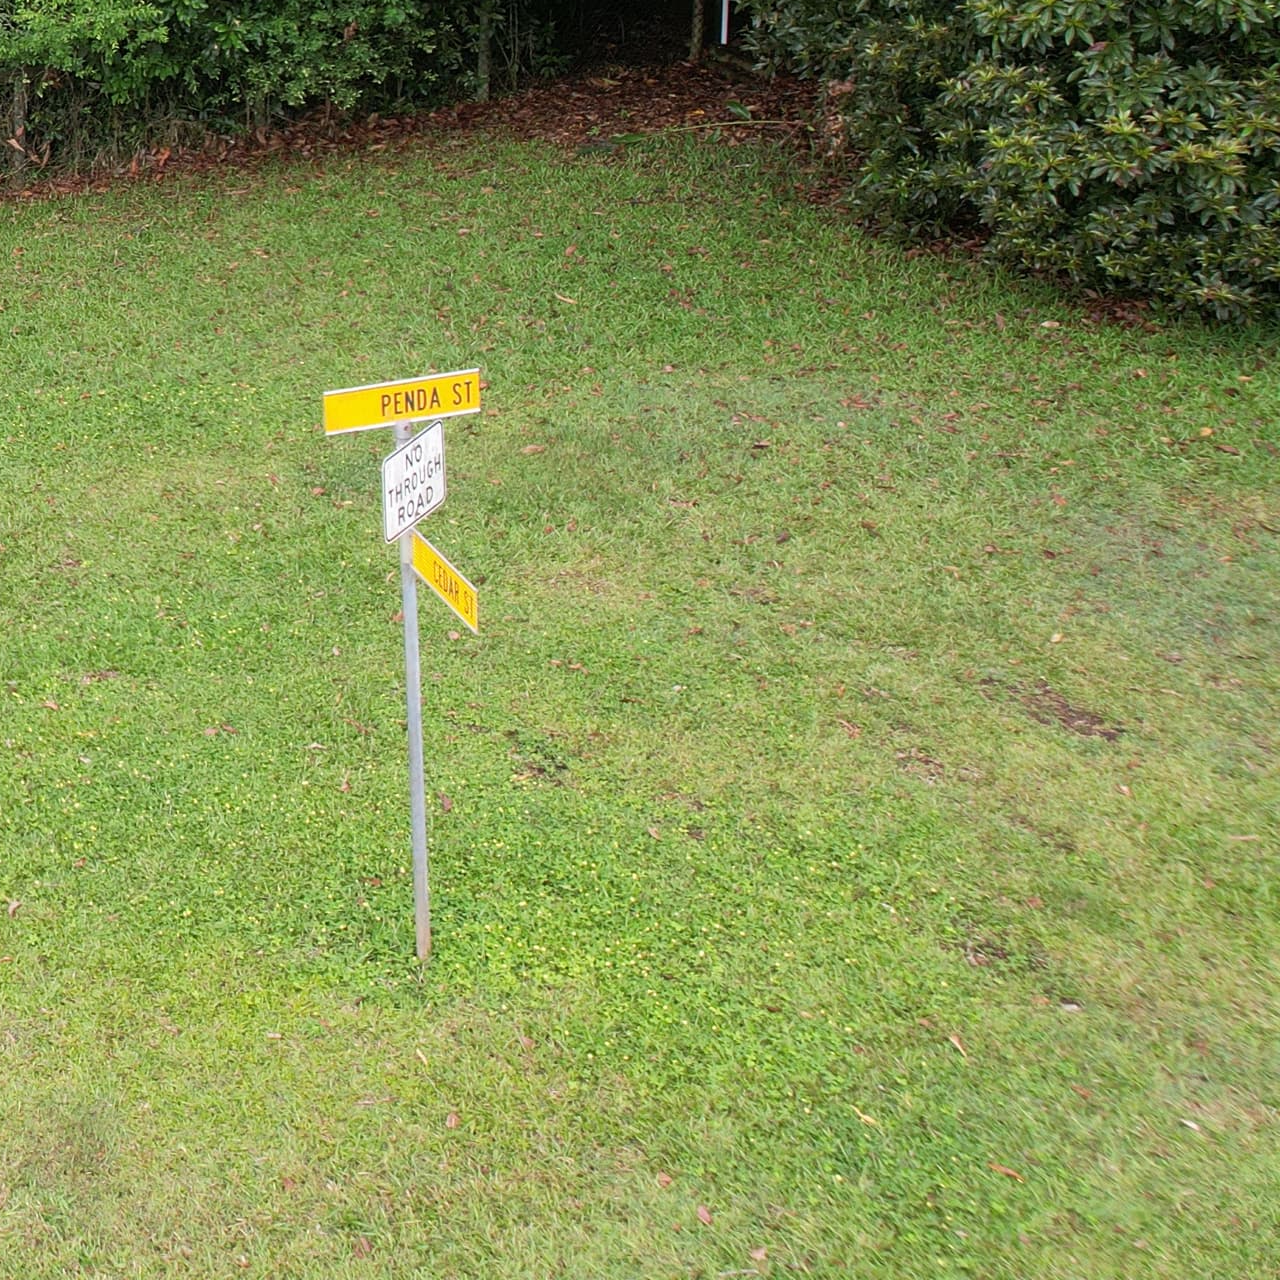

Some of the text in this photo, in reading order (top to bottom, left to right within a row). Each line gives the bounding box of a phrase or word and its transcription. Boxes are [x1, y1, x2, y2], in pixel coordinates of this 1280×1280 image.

[381, 381, 473, 417] PENDA ST
[405, 444, 423, 472] NO
[388, 453, 441, 508] THROUGH
[397, 486, 434, 526] ROAD
[464, 590, 473, 619] ST
